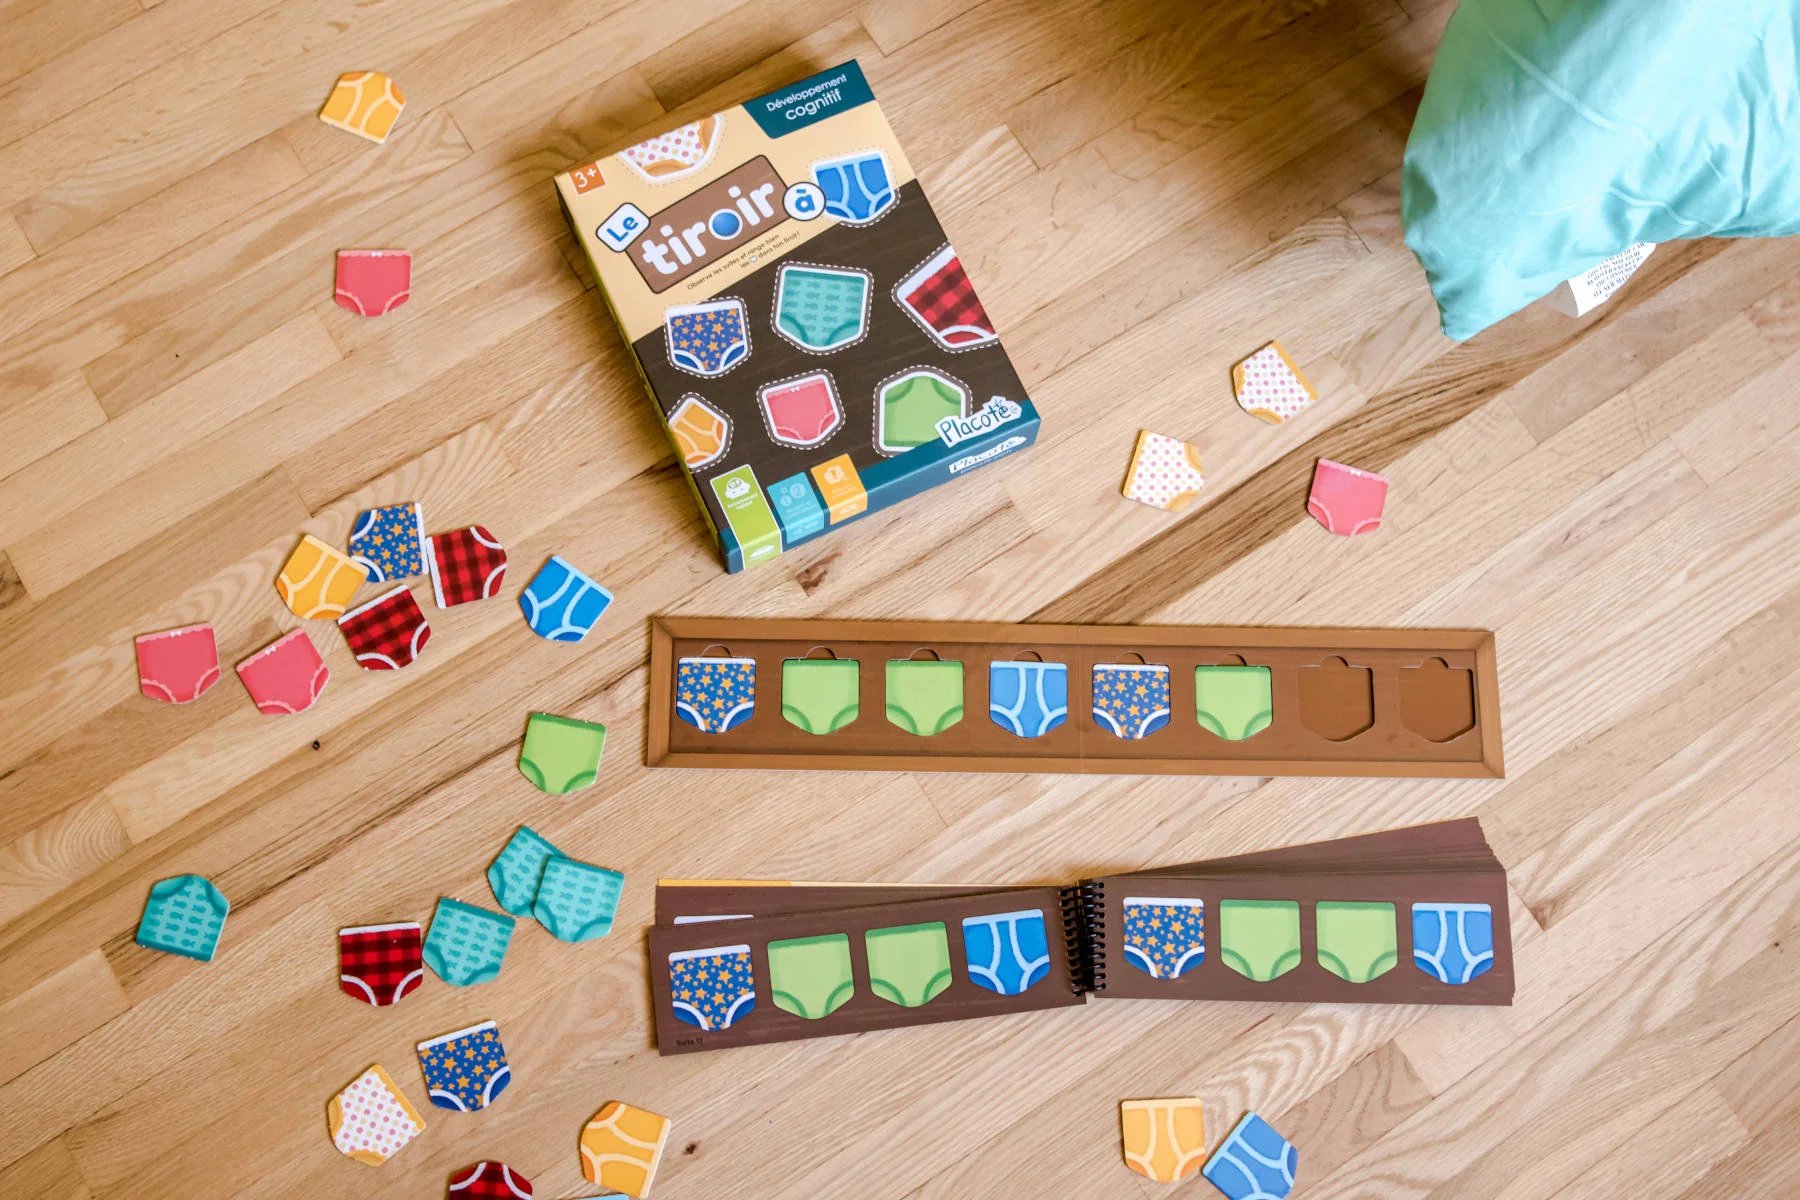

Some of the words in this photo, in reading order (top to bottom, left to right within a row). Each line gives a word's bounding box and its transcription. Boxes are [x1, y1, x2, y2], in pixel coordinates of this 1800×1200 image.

[766, 74, 847, 112] Développement
[785, 88, 842, 120] cognitif
[576, 167, 597, 188] 3+
[794, 188, 816, 213] à
[606, 215, 639, 242] Le
[641, 182, 774, 275] tiroir
[687, 273, 713, 290] Observe
